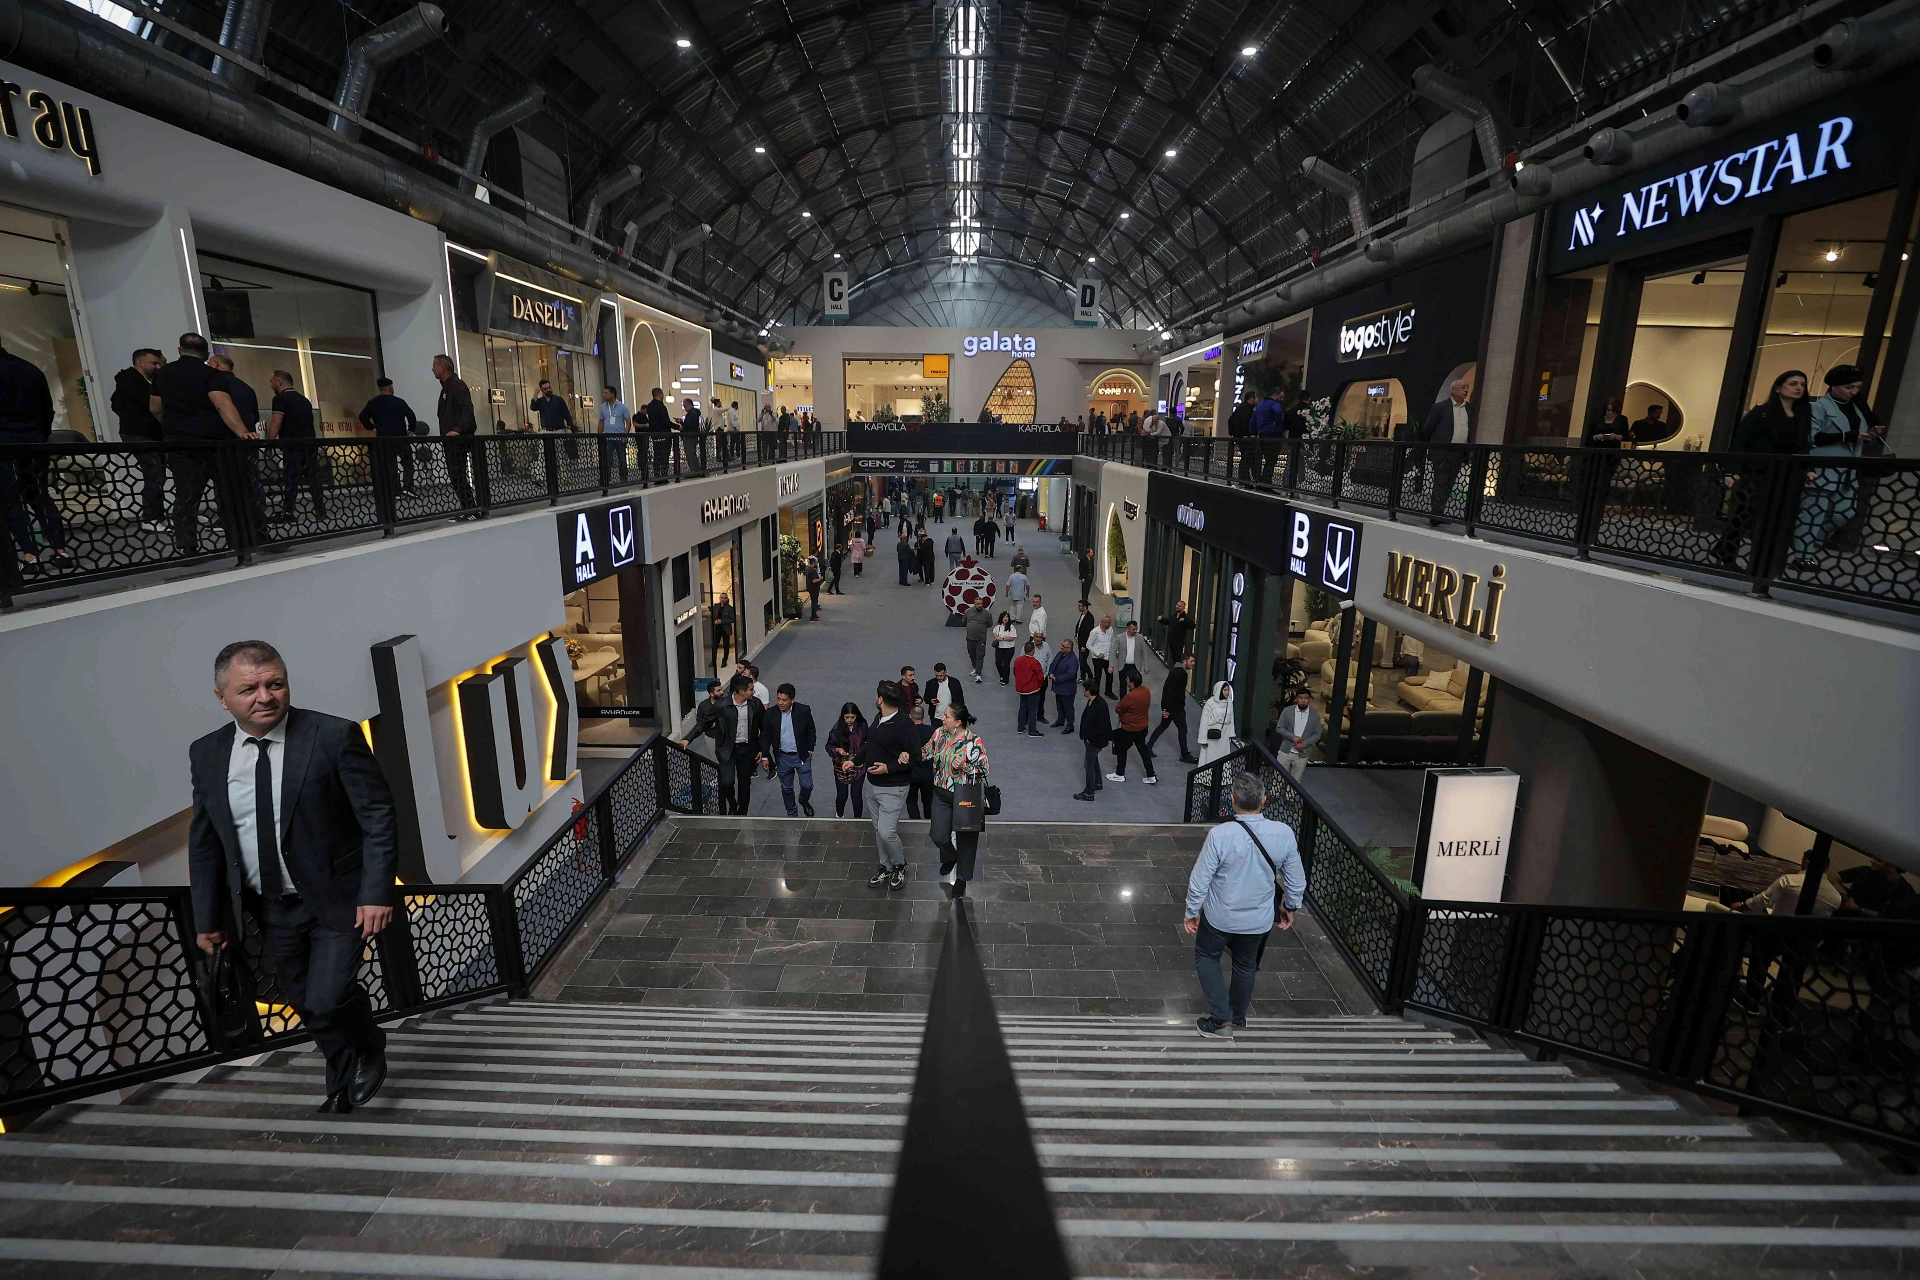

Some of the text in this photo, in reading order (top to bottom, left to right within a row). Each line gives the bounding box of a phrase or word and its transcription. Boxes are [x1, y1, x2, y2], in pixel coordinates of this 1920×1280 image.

[1616, 116, 1854, 237] NEWSTAR
[828, 277, 843, 301] C
[1080, 284, 1096, 308] D
[512, 294, 569, 331] DASELL
[963, 330, 1037, 357] galata
[1340, 308, 1416, 360] togostyle
[1012, 349, 1036, 358] home
[858, 460, 896, 469] GENÇ
[704, 494, 735, 523] AYHAN
[575, 512, 595, 564] A
[1291, 511, 1310, 558] B
[576, 562, 597, 584] HALL
[1290, 556, 1307, 577] HALL
[1383, 550, 1507, 642] MERLİ
[1437, 836, 1501, 858] MERLİ
